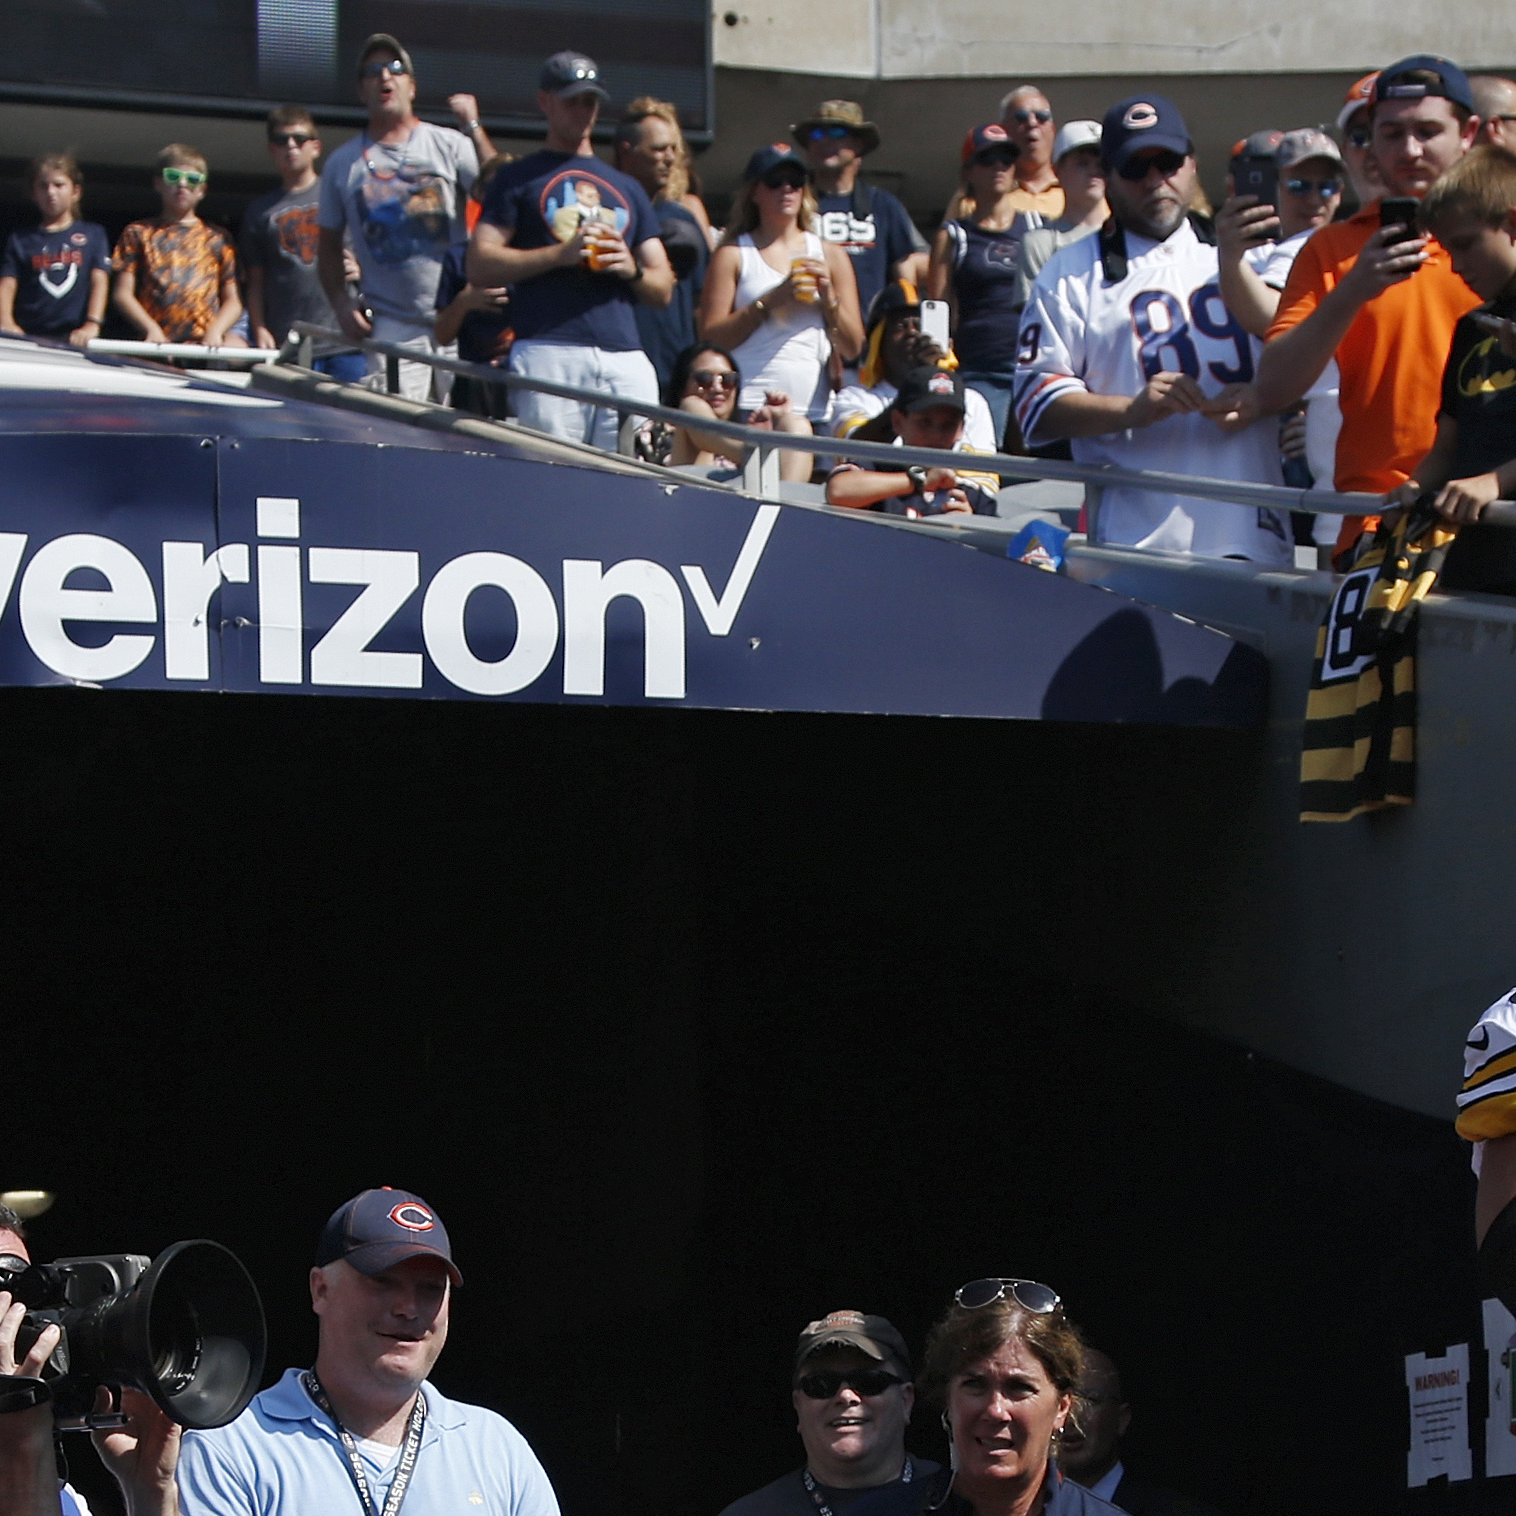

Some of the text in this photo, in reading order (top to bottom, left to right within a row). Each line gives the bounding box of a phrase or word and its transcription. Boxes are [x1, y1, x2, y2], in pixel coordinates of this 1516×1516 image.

[1130, 282, 1254, 384] 89
[1414, 1368, 1460, 1392] WARNING!
[401, 1430, 420, 1471] TICKET
